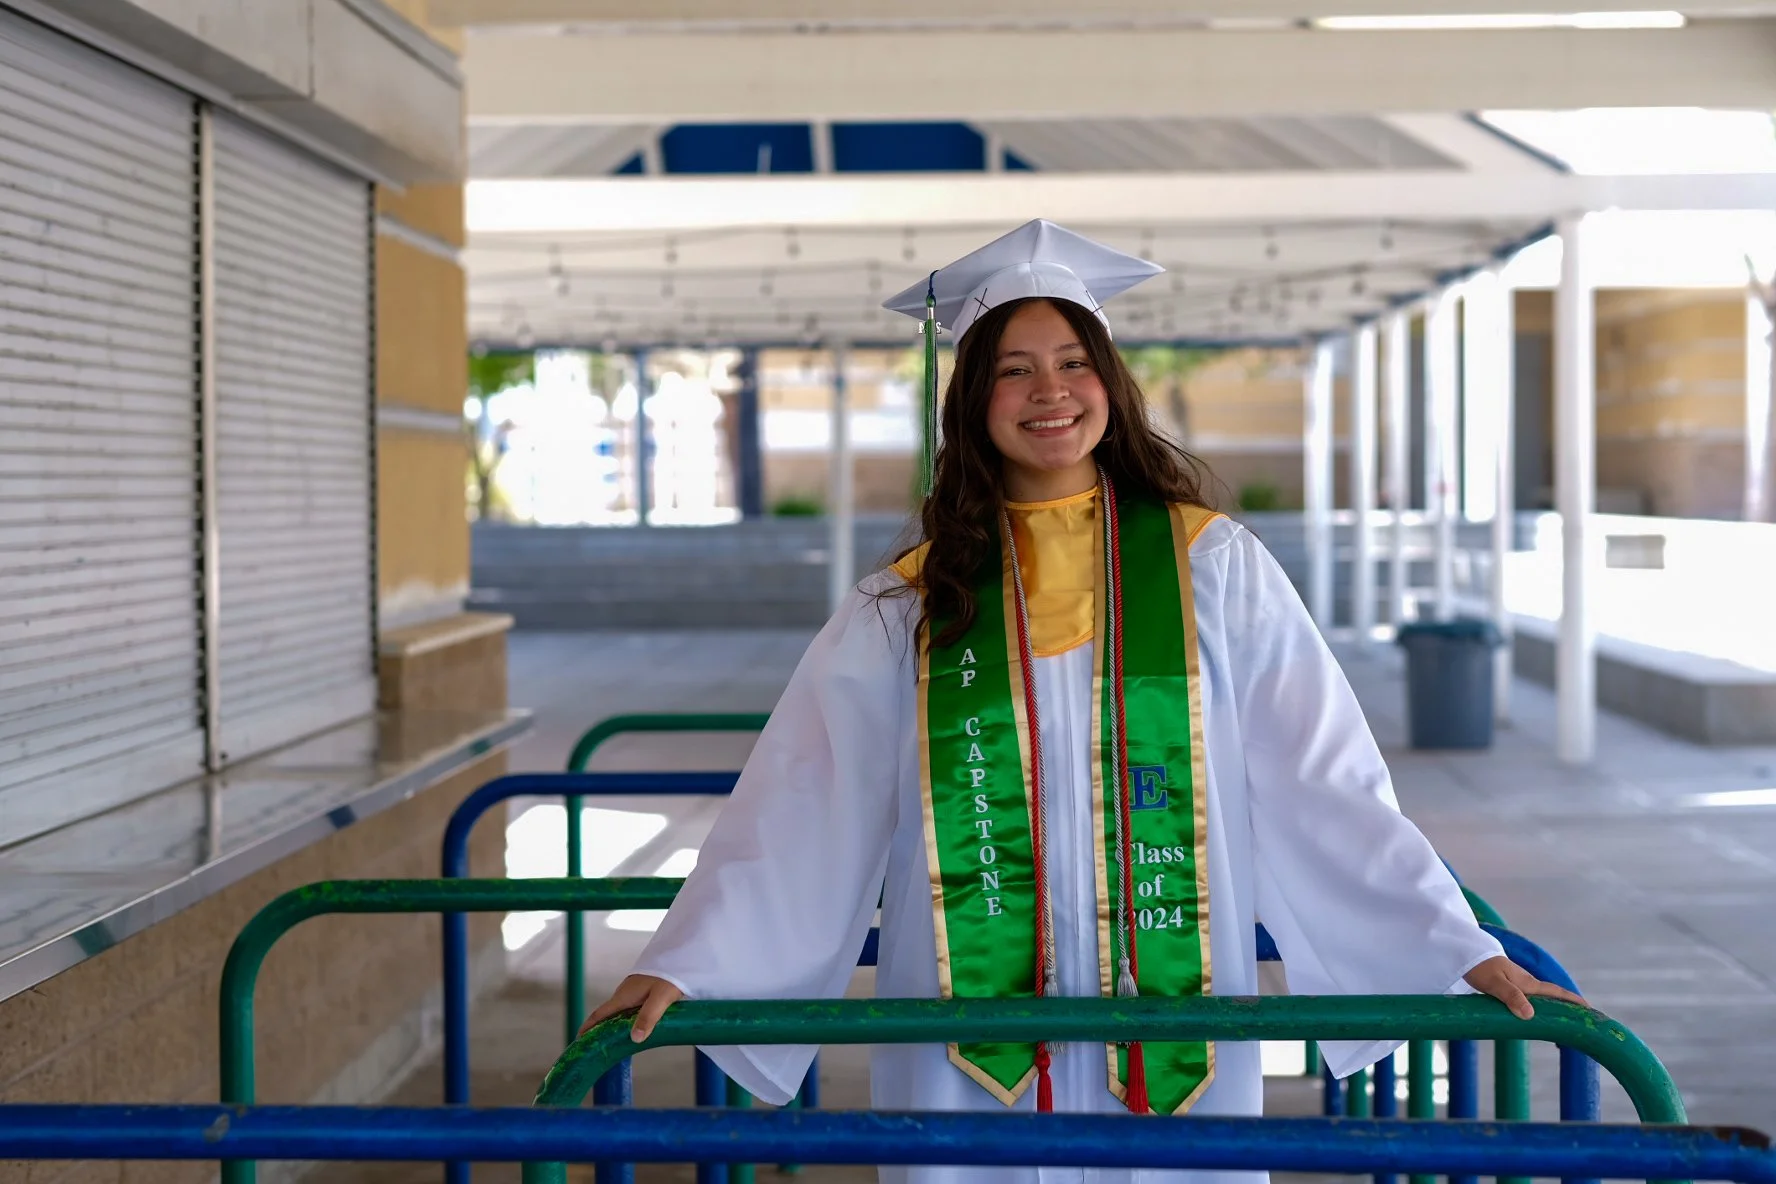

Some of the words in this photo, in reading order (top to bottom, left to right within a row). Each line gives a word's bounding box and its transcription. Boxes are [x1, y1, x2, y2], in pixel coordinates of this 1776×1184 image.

[959, 648, 977, 687] AP
[1127, 765, 1168, 811] E
[965, 717, 1002, 916] CAPSTONE
[1138, 874, 1165, 898] of
